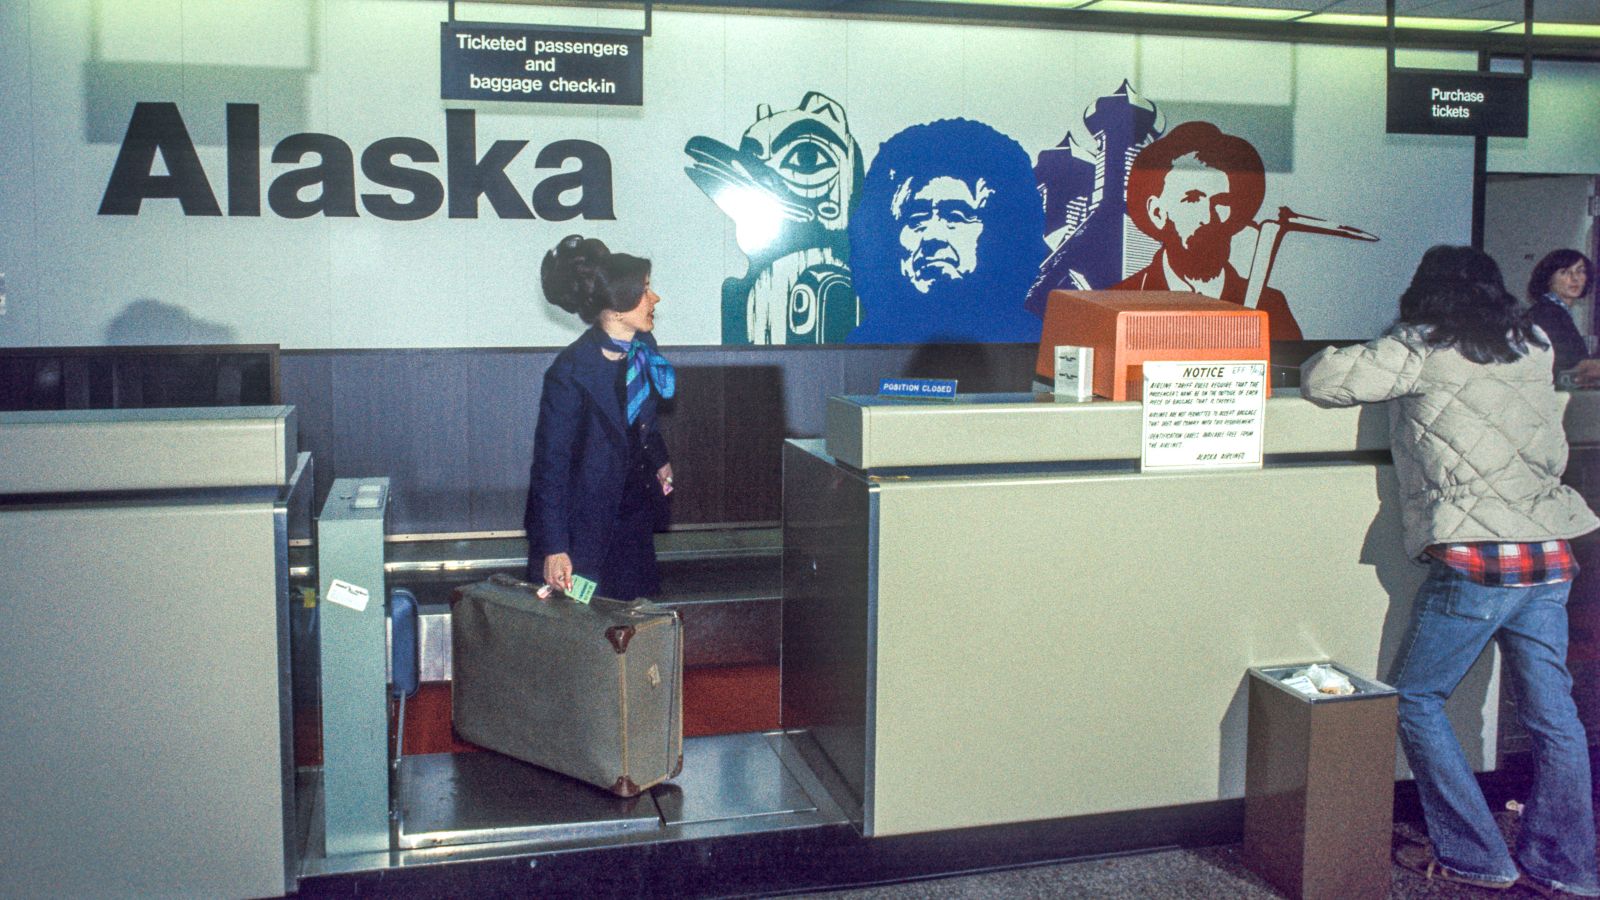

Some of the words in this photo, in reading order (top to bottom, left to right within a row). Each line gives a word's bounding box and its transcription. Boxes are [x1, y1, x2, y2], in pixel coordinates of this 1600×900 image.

[456, 34, 526, 51] Ticketed
[534, 40, 628, 57] passengers
[525, 57, 556, 72] and
[470, 74, 543, 93] baggage
[549, 77, 616, 93] check-in
[1431, 87, 1484, 103] Purchase
[1432, 105, 1470, 118] tickets
[97, 101, 617, 222] Alaska
[1183, 367, 1225, 378] NOTICE
[883, 383, 919, 392] POSITION
[921, 385, 952, 393] CLOSED
